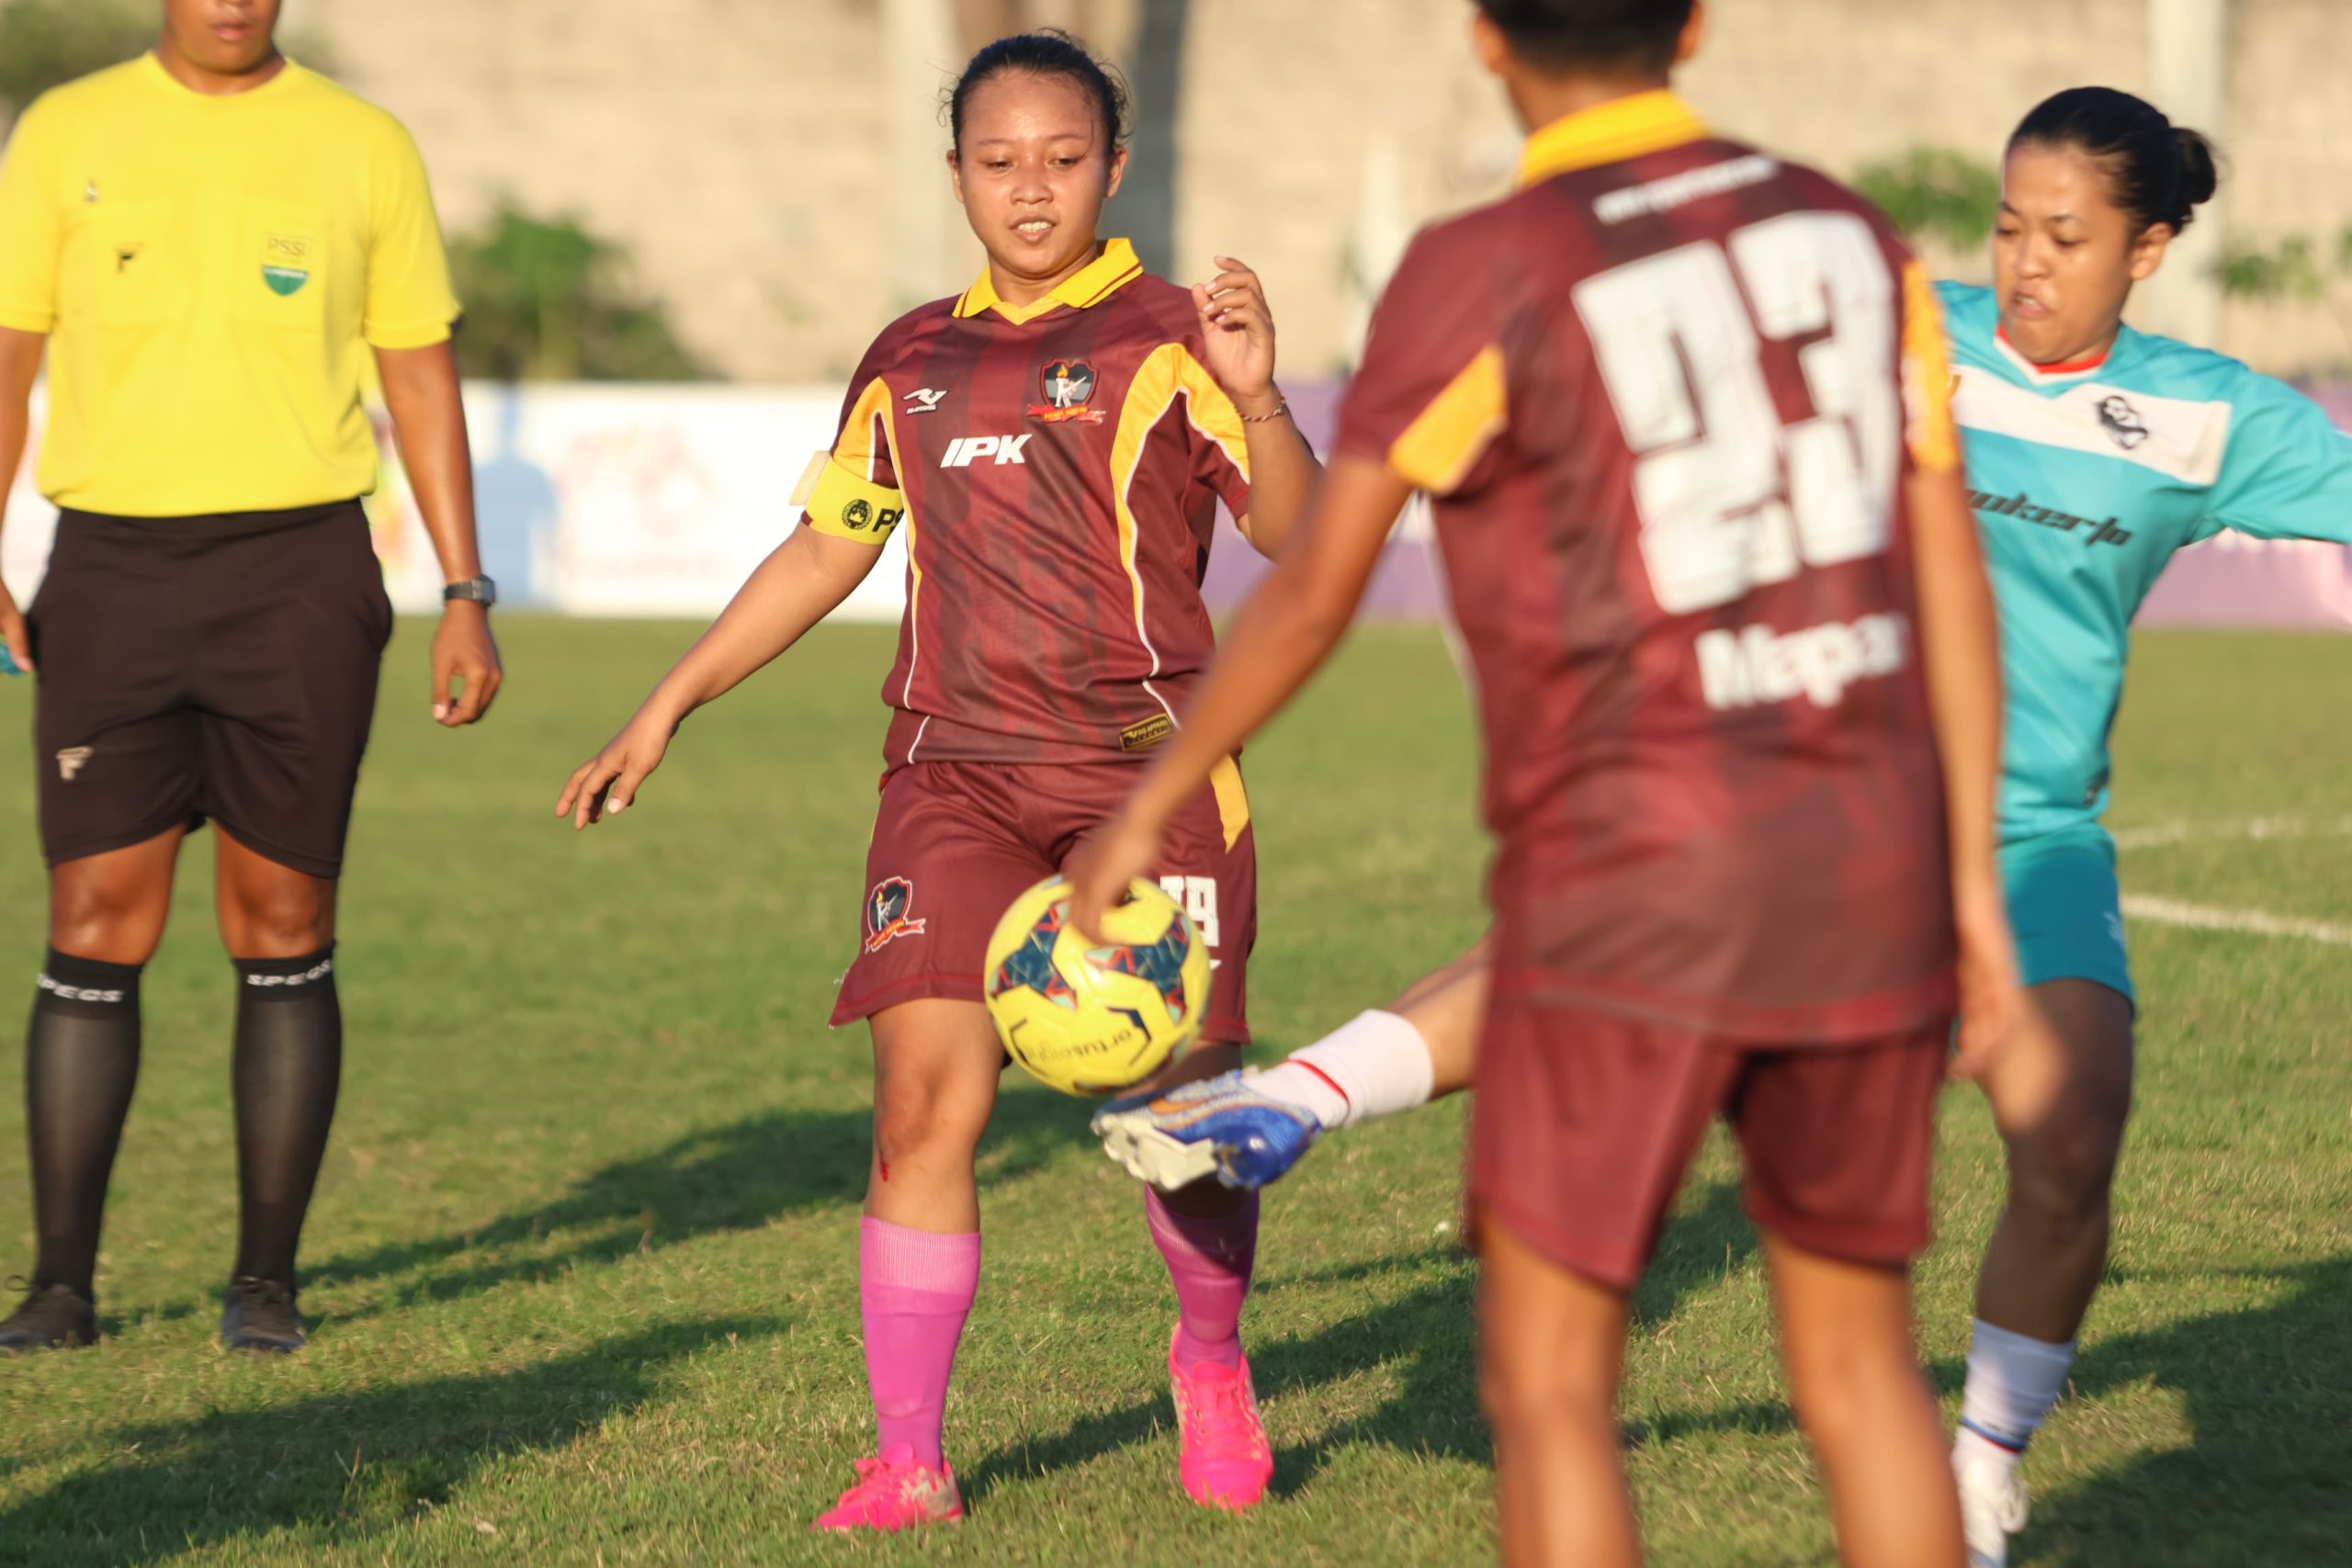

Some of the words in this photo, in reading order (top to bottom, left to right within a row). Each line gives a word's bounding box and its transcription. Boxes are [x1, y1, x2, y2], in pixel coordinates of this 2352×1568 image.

[1570, 211, 1895, 614] 23
[940, 434, 1034, 468] IPK
[247, 960, 331, 986] SPECS
